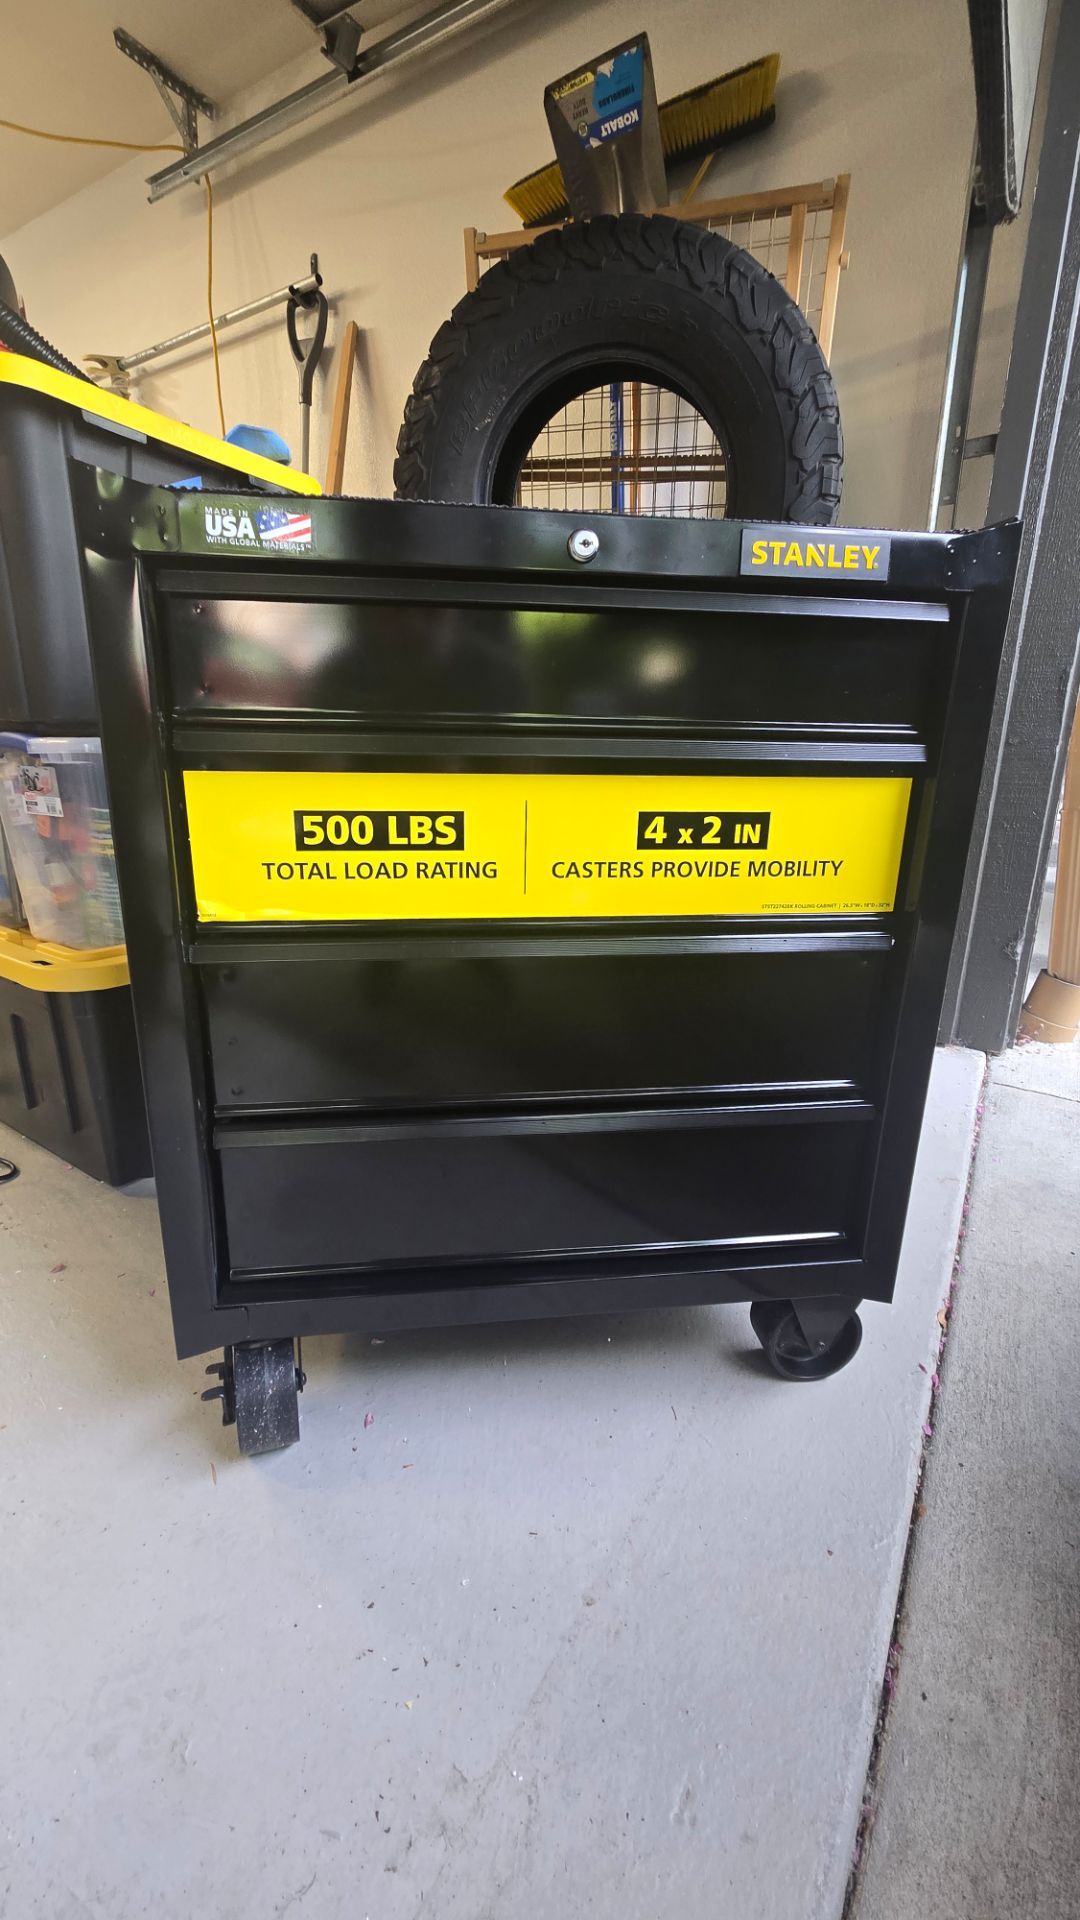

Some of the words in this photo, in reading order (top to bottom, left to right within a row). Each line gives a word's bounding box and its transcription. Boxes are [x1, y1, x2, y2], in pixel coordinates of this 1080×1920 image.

[601, 109, 639, 137] KOBALT
[205, 506, 232, 515] MADE
[205, 514, 256, 539] USA
[206, 536, 227, 544] WITH
[229, 537, 261, 548] GLOBAL
[751, 540, 880, 569] STANLEY
[302, 815, 374, 846] 500
[387, 815, 457, 845] LBS
[644, 816, 667, 844] 4
[677, 828, 694, 844] x
[701, 816, 722, 844] 2
[734, 824, 762, 844] IN
[261, 862, 337, 880] TOTAL
[344, 862, 409, 879] LOAD
[416, 861, 498, 879] RATING
[551, 861, 644, 879] CASTERS
[651, 861, 741, 878] PROVIDE
[748, 860, 844, 877] MOBILITY
